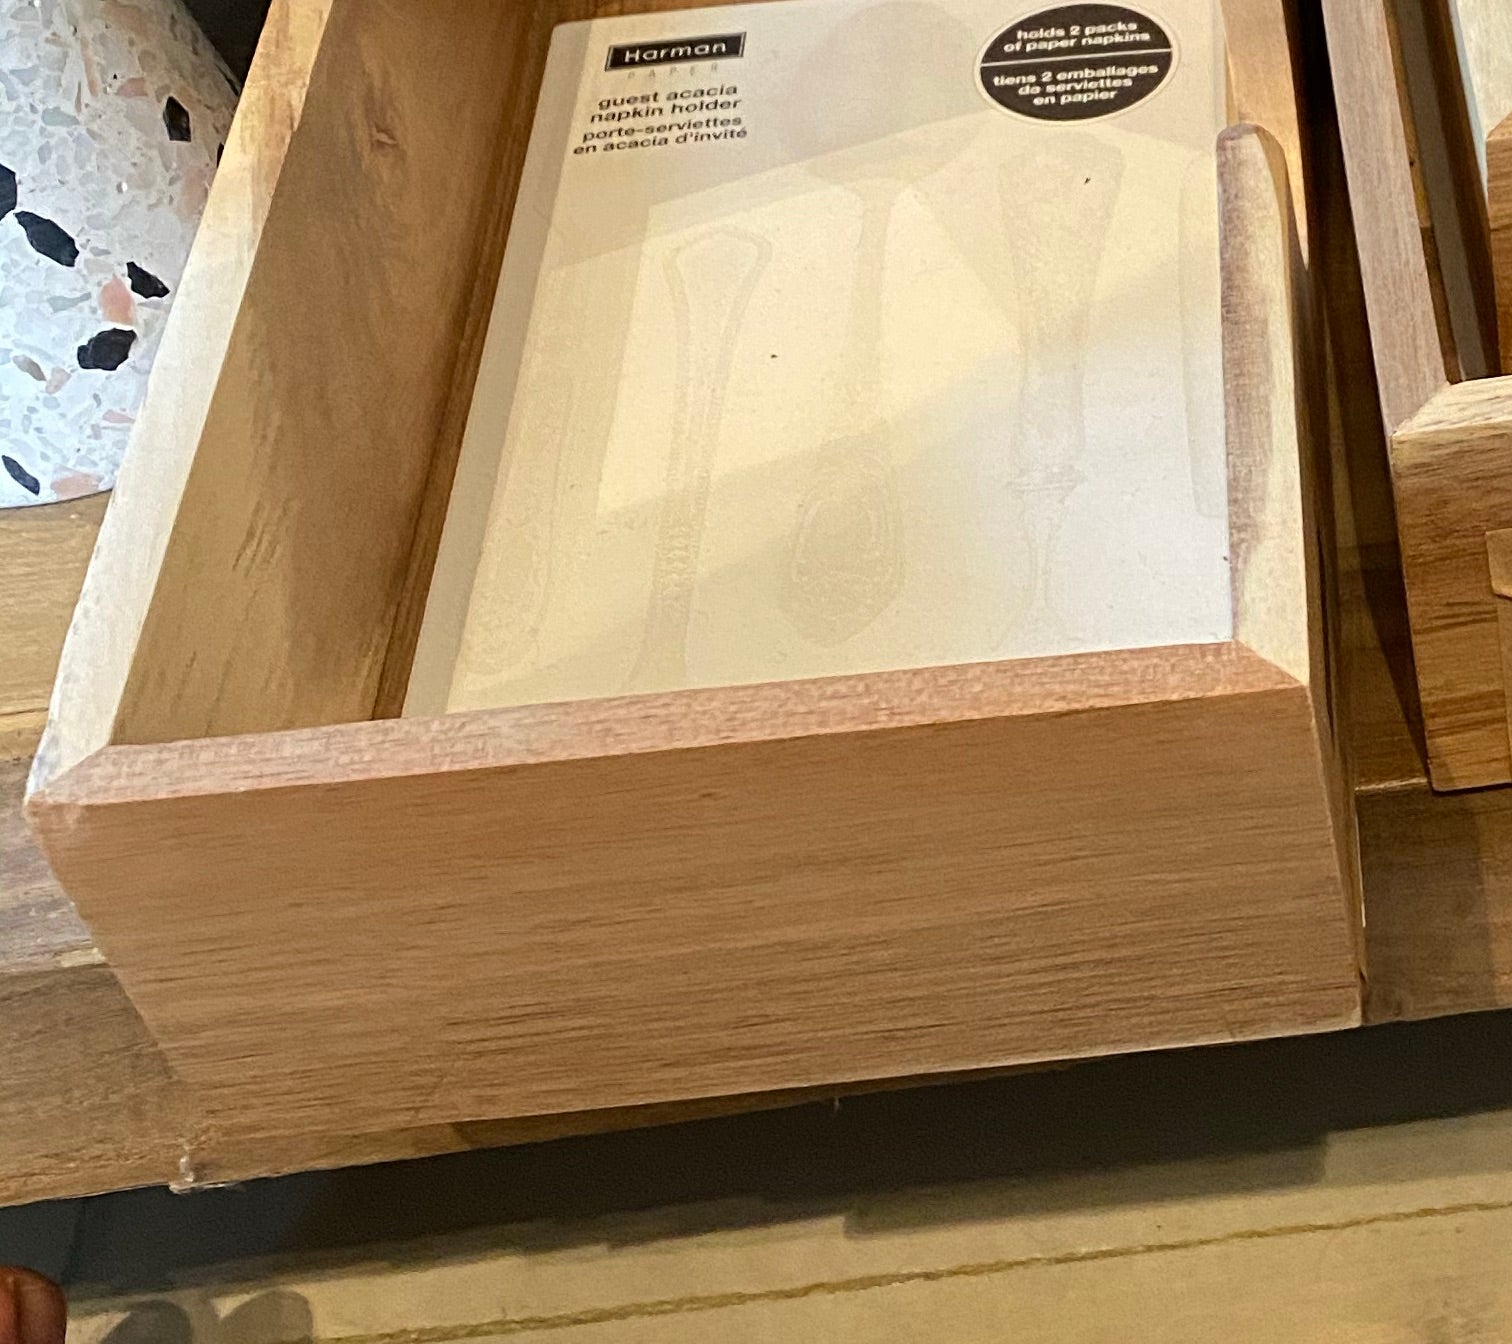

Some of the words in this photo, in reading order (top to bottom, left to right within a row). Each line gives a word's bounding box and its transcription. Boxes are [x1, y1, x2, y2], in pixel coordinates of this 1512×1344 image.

[1017, 27, 1065, 40] holds
[1070, 25, 1080, 36] 2
[1085, 21, 1138, 36] packs
[624, 42, 727, 63] Harman
[1004, 41, 1022, 53] of
[1026, 37, 1076, 53] paper
[1081, 31, 1150, 47] napkins
[993, 73, 1037, 86] tiens
[1041, 71, 1052, 82] 2
[1056, 64, 1159, 81] emballages
[598, 91, 658, 110] guest
[666, 83, 738, 101] acacia
[1018, 84, 1040, 96] de
[1046, 77, 1133, 93] serviettes
[1033, 94, 1055, 106] en
[1060, 89, 1117, 105] papier
[591, 104, 664, 123] napkin
[671, 98, 742, 114] holder
[583, 116, 742, 142] porte-serviettes
[573, 143, 597, 155] en
[603, 134, 668, 152] acacia
[675, 126, 747, 144] d'invité
